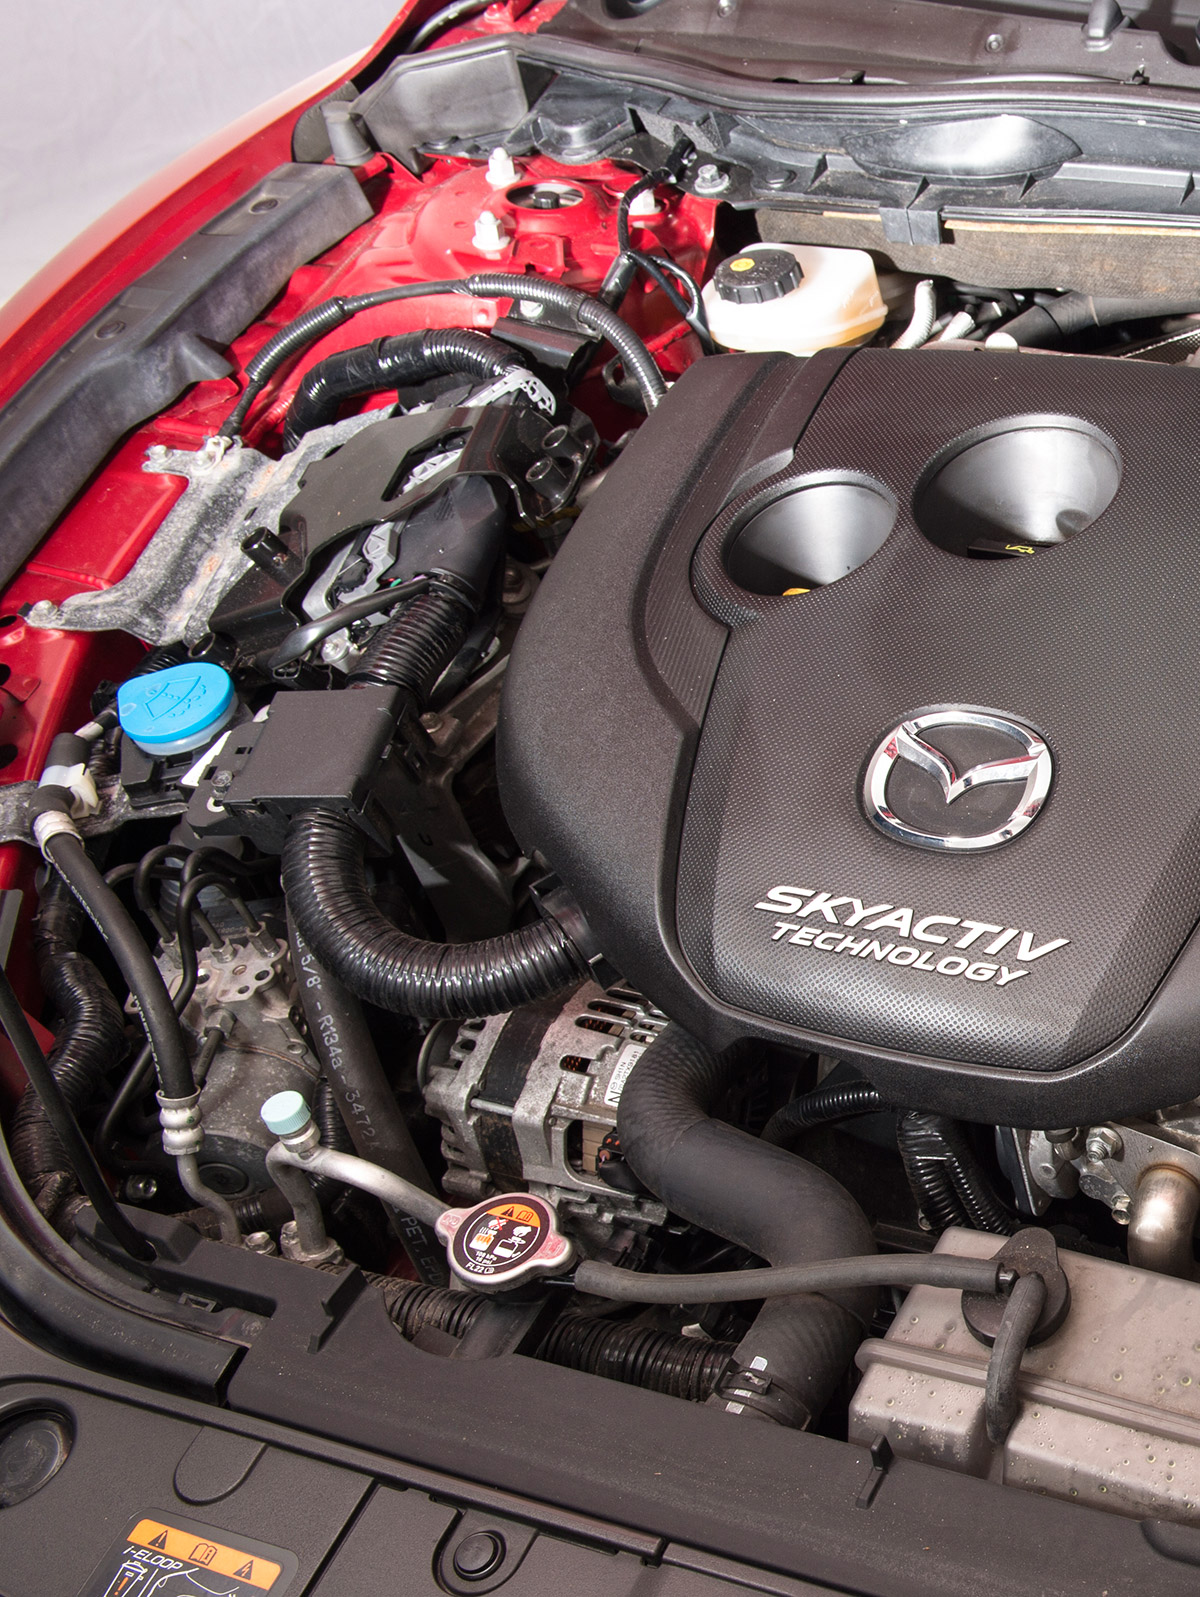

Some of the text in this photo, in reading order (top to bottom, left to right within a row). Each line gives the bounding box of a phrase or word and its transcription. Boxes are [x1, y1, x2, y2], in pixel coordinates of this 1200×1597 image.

[754, 885, 1071, 962] SKYACTIV
[771, 921, 1031, 986] TECHNOLOGY
[318, 1014, 343, 1070] R134a
[465, 1262, 485, 1274] FL22
